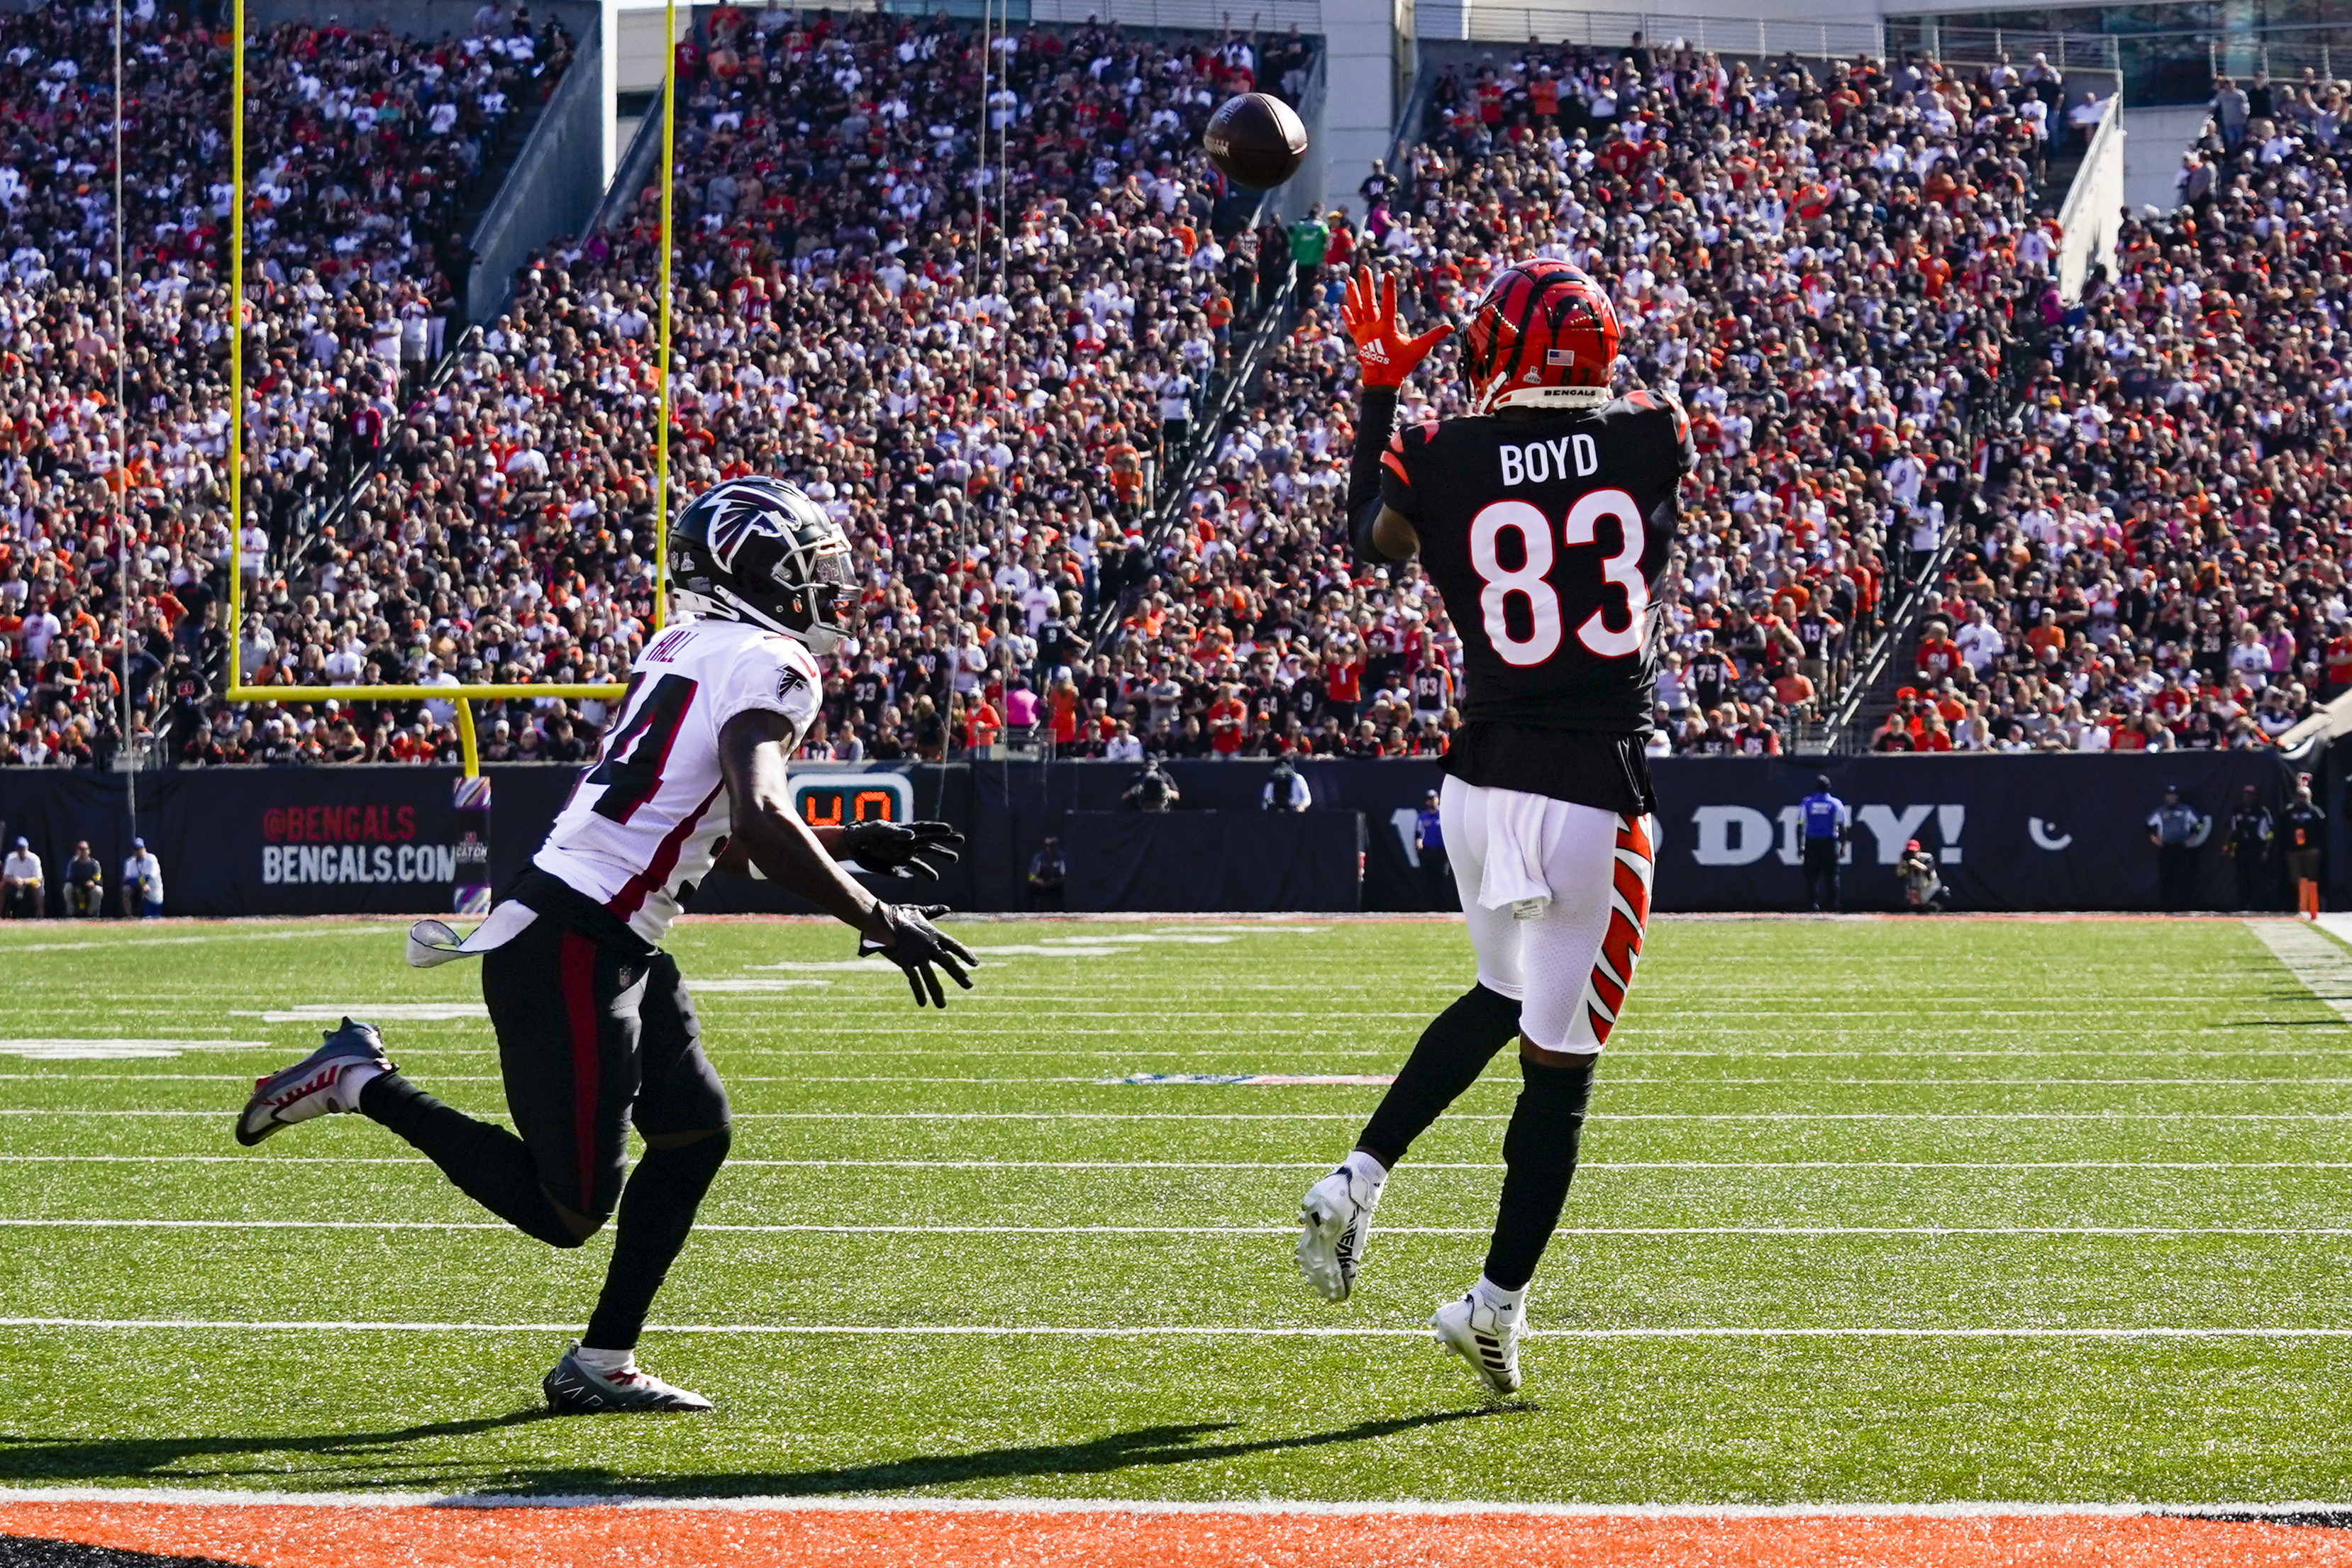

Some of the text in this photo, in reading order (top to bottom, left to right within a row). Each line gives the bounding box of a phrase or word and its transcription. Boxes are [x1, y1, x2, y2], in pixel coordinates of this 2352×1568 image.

[1359, 350, 1390, 365] adidas
[1499, 433, 1598, 486] BOYD
[1468, 486, 1650, 668] 83
[645, 630, 699, 663] HALL
[1419, 677, 1438, 696] 83
[1696, 664, 1716, 682] 75
[263, 806, 416, 841] @BENGALS
